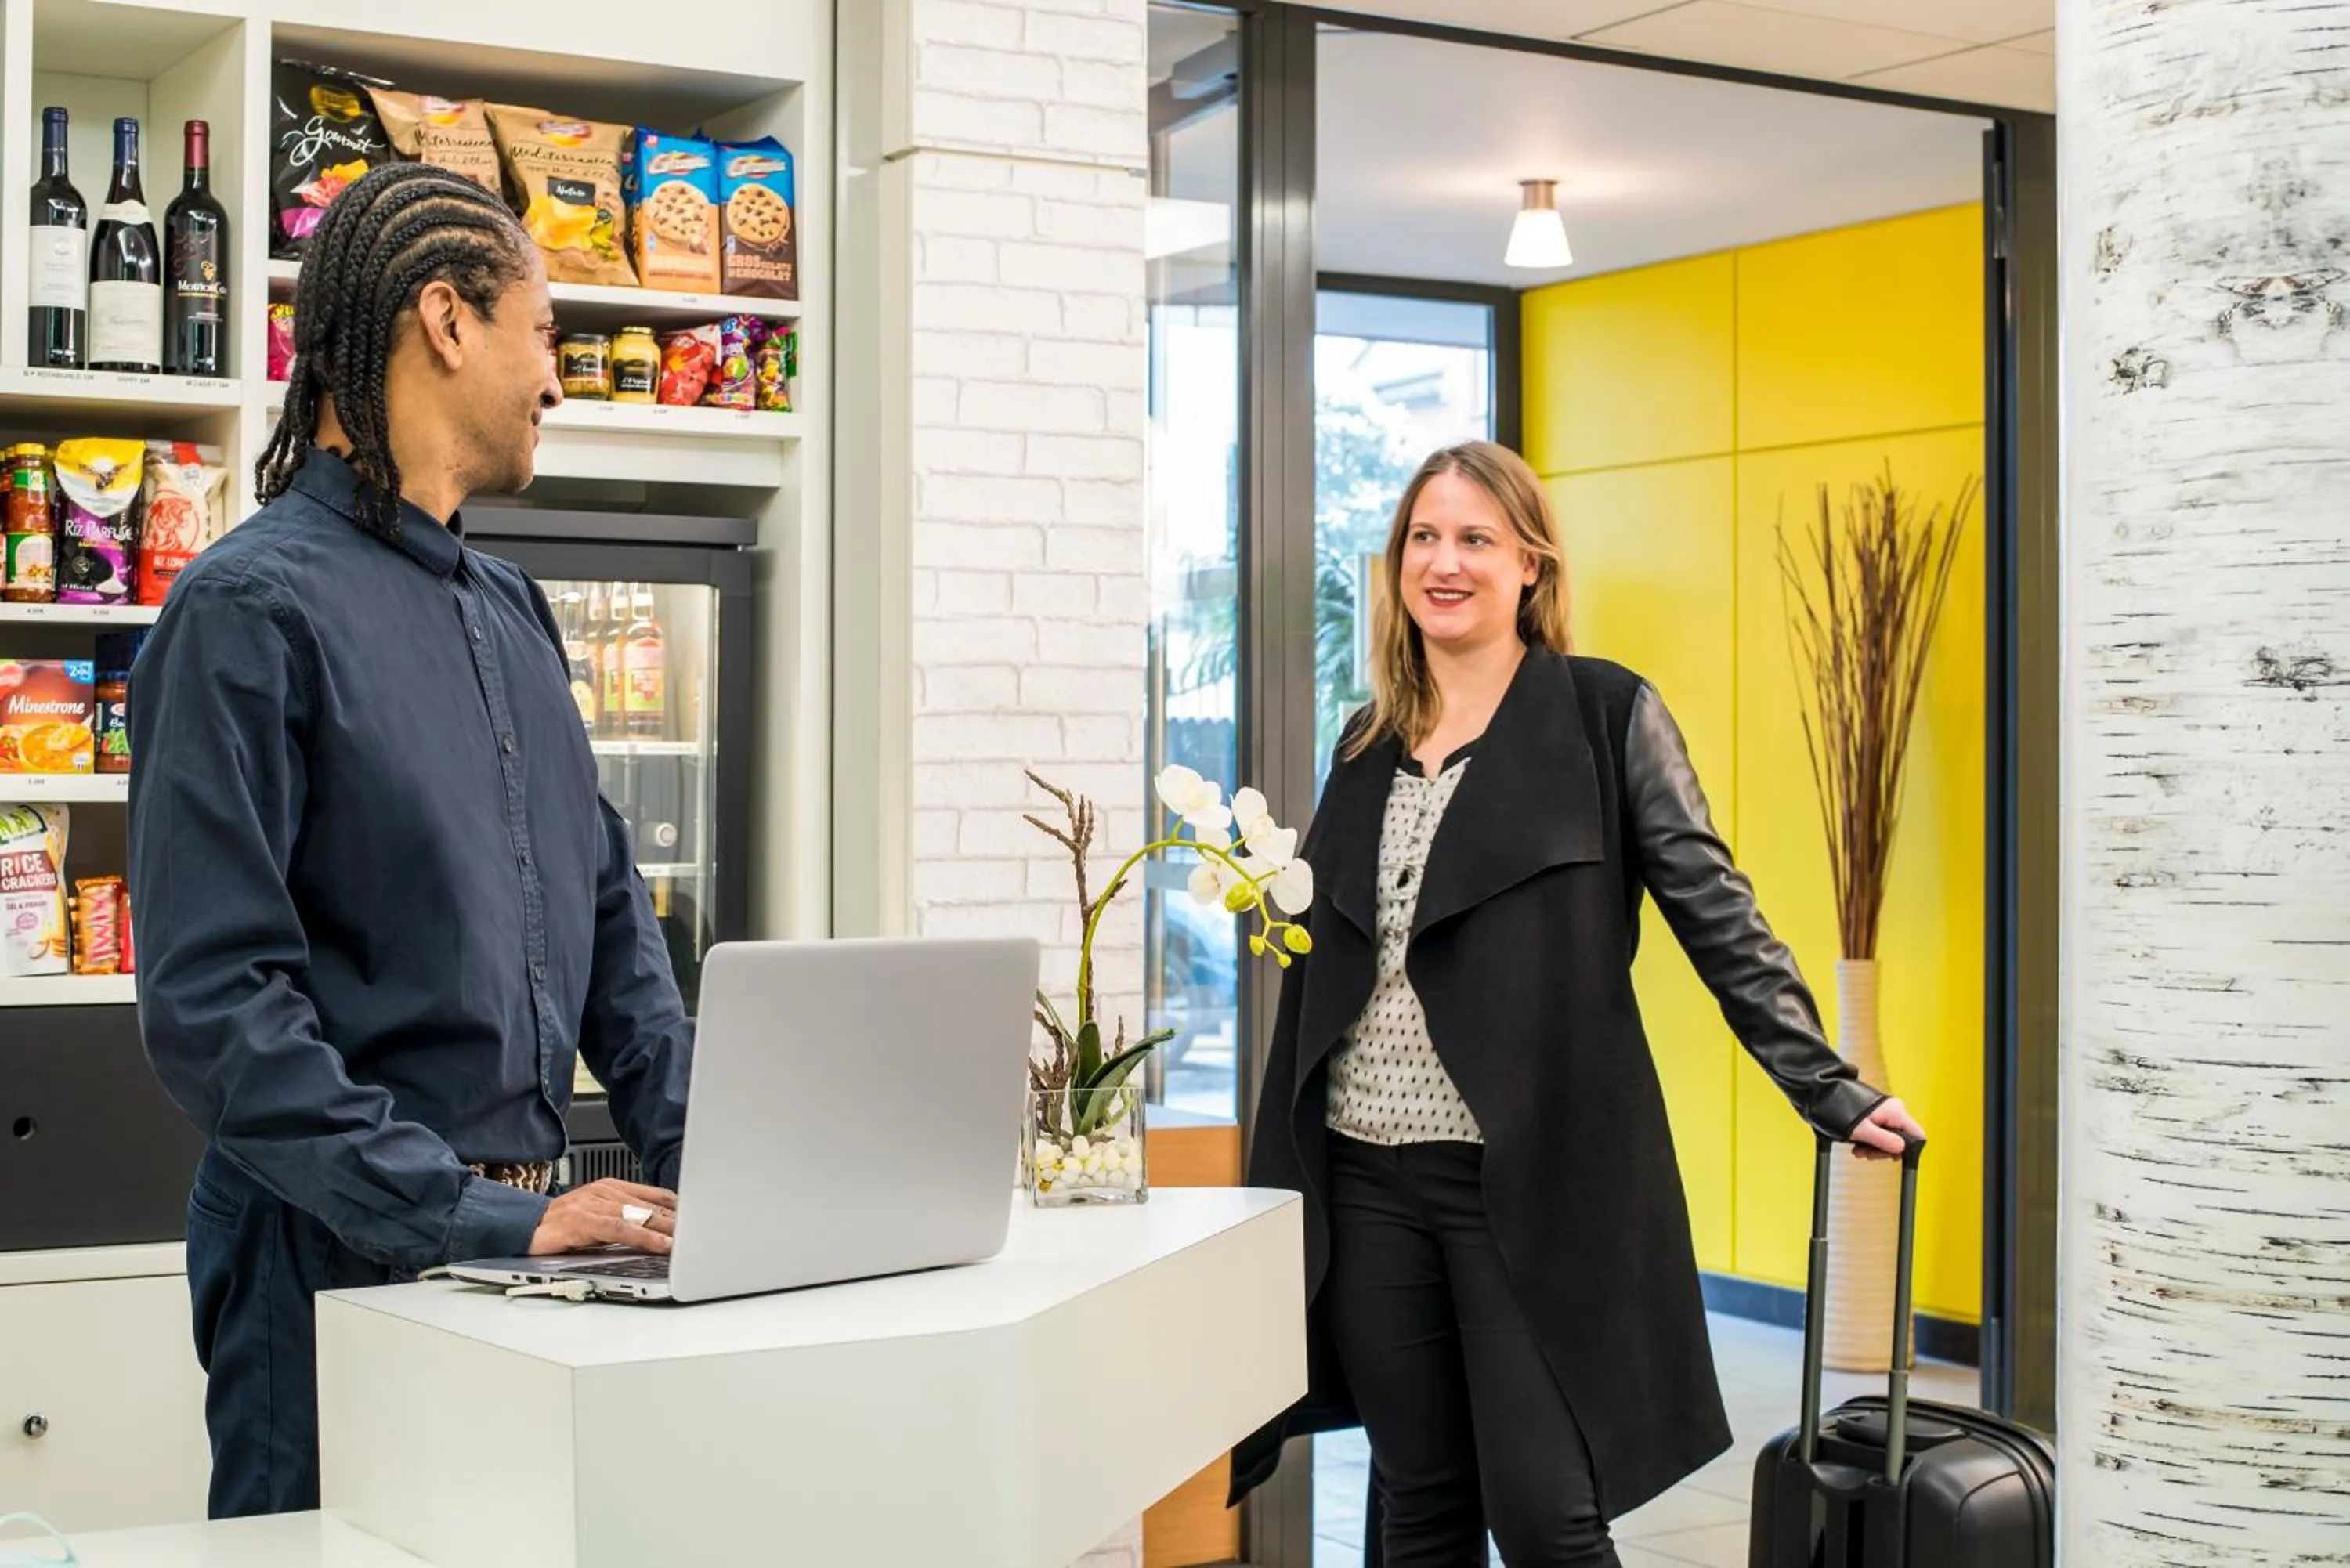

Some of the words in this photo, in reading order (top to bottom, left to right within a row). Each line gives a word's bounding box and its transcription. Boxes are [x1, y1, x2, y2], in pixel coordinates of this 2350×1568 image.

[727, 254, 761, 268] GROS
[9, 695, 85, 714] Minestrone
[2, 853, 45, 877] RICE
